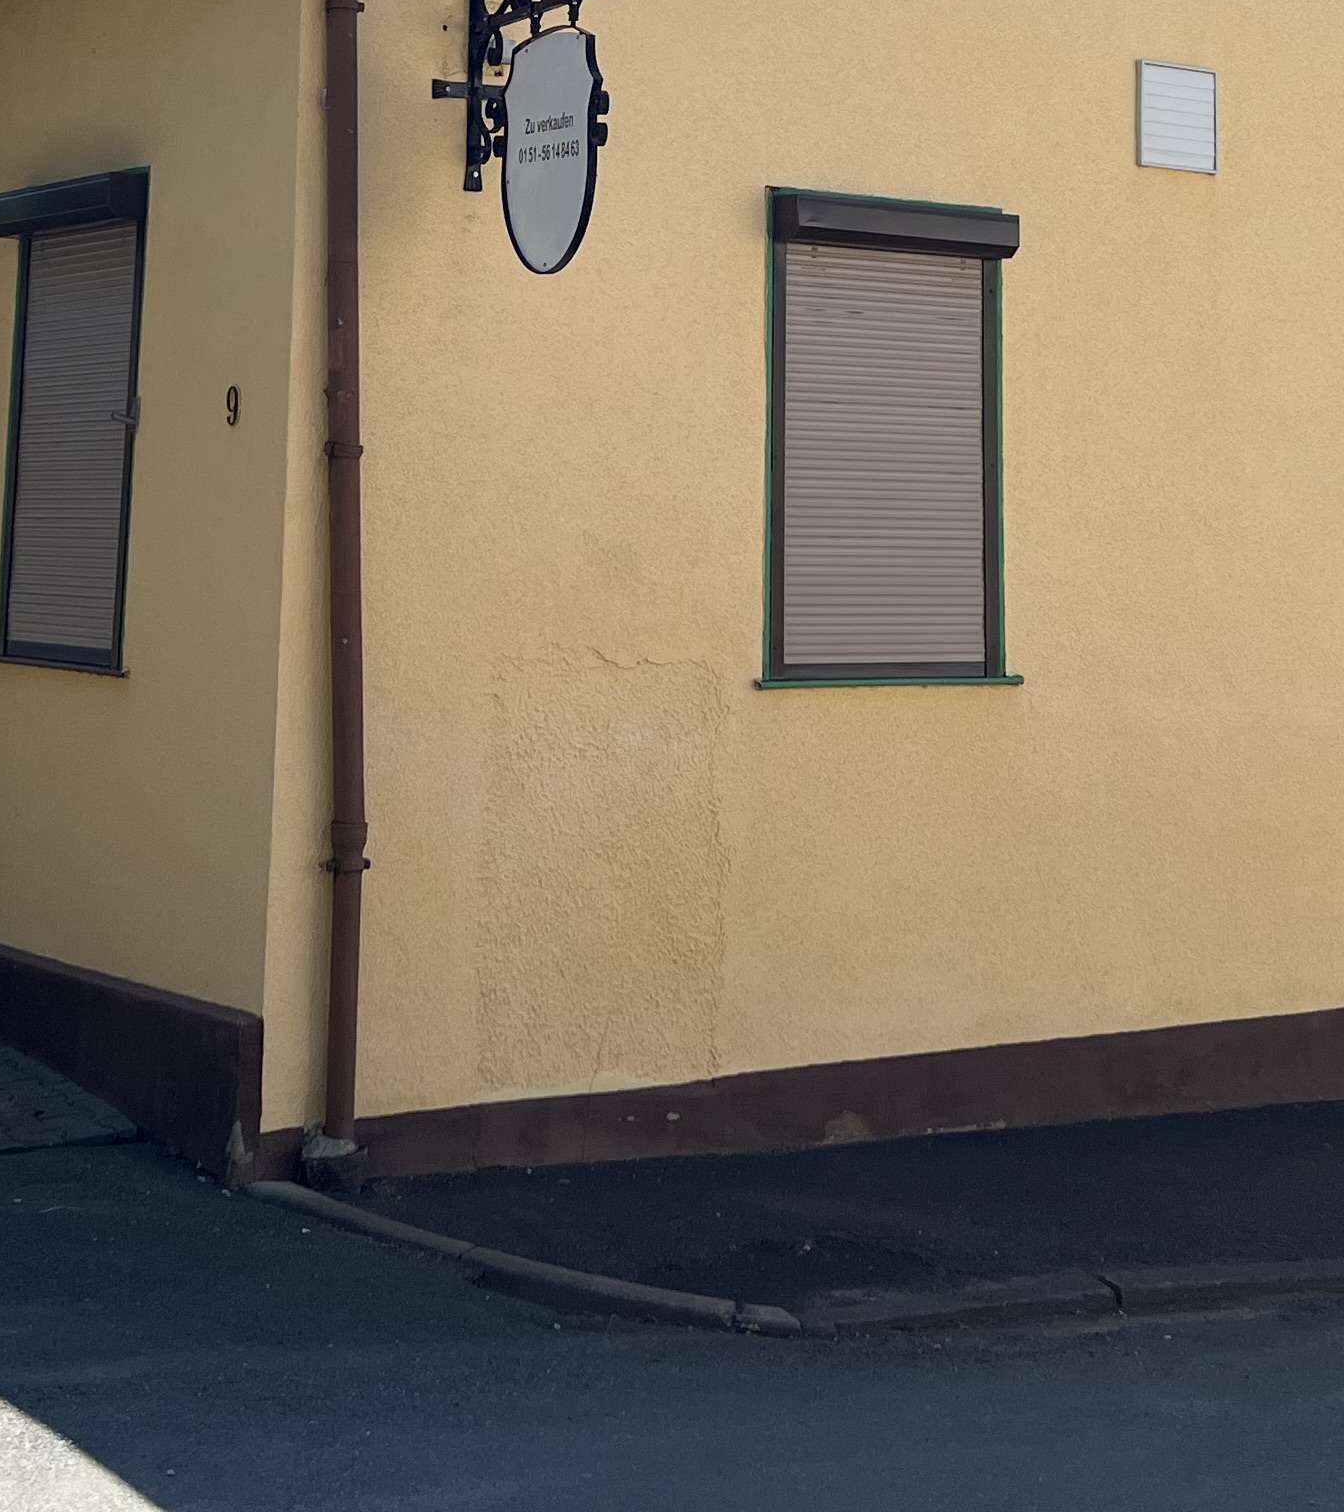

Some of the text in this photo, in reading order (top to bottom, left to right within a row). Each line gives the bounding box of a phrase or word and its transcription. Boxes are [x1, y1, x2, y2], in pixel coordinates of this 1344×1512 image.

[525, 112, 574, 135] Zu verkaufen
[226, 385, 239, 426] 9
